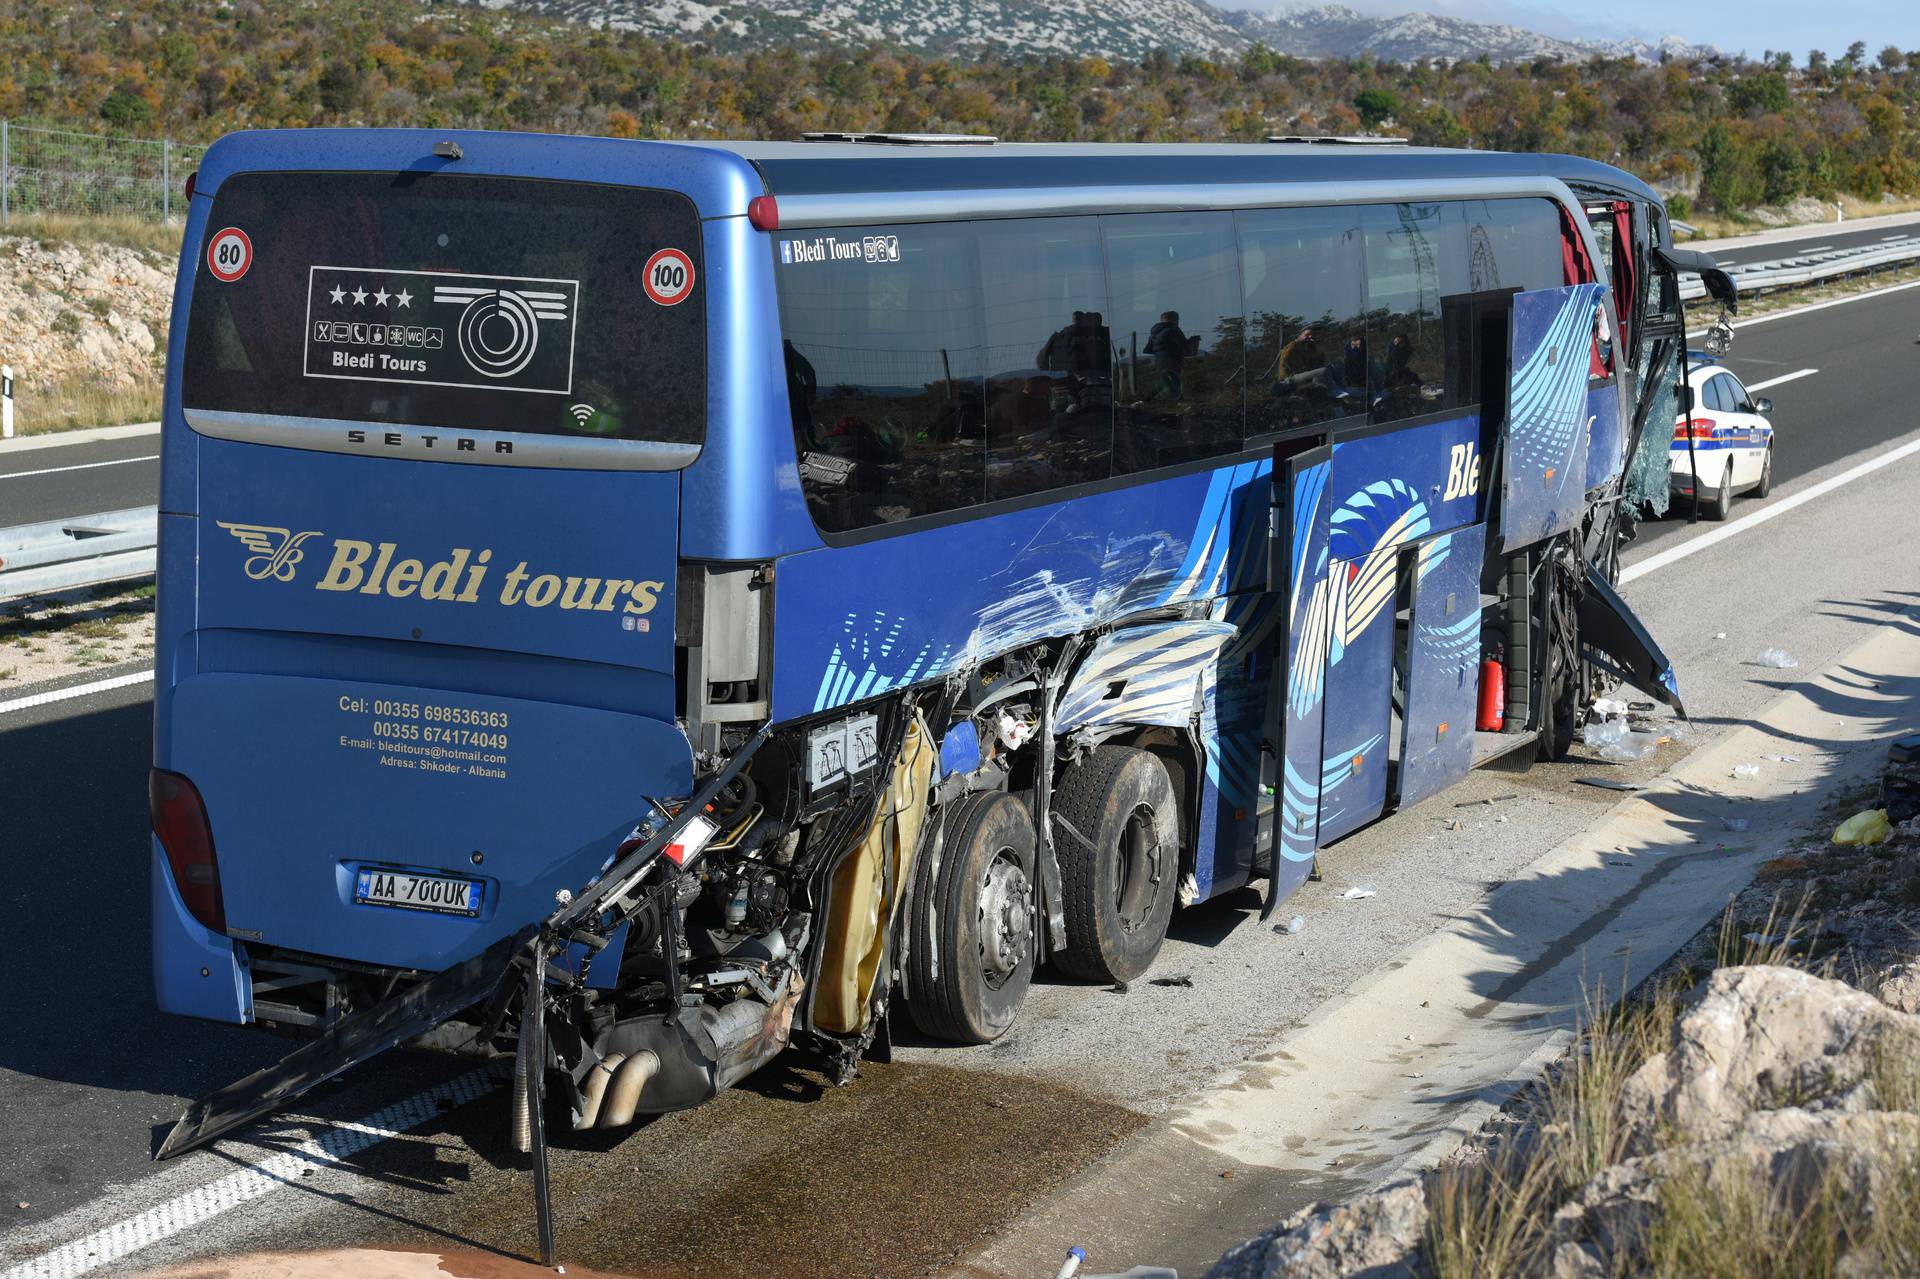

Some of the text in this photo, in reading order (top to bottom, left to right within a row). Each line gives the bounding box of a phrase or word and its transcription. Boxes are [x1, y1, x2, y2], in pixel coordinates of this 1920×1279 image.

[219, 244, 240, 265] 80
[792, 239, 825, 262] Bledi
[826, 237, 861, 259] Tours
[654, 264, 684, 288] 100
[407, 331, 422, 342] WC
[332, 351, 427, 372] Bledi Tours
[348, 430, 513, 454] SETRA
[1443, 441, 1482, 502] Ble
[315, 538, 665, 614] Bledi tours
[339, 696, 508, 728] Cel: 00355 698536363
[373, 721, 508, 749] 00355 674174049
[340, 735, 507, 764] E-mail: bleditours@hotmail.com
[380, 755, 417, 769] Adresa:
[420, 759, 461, 774] Shkoder
[468, 765, 506, 779] Albania
[359, 887, 368, 896] AL
[372, 874, 396, 898] AA
